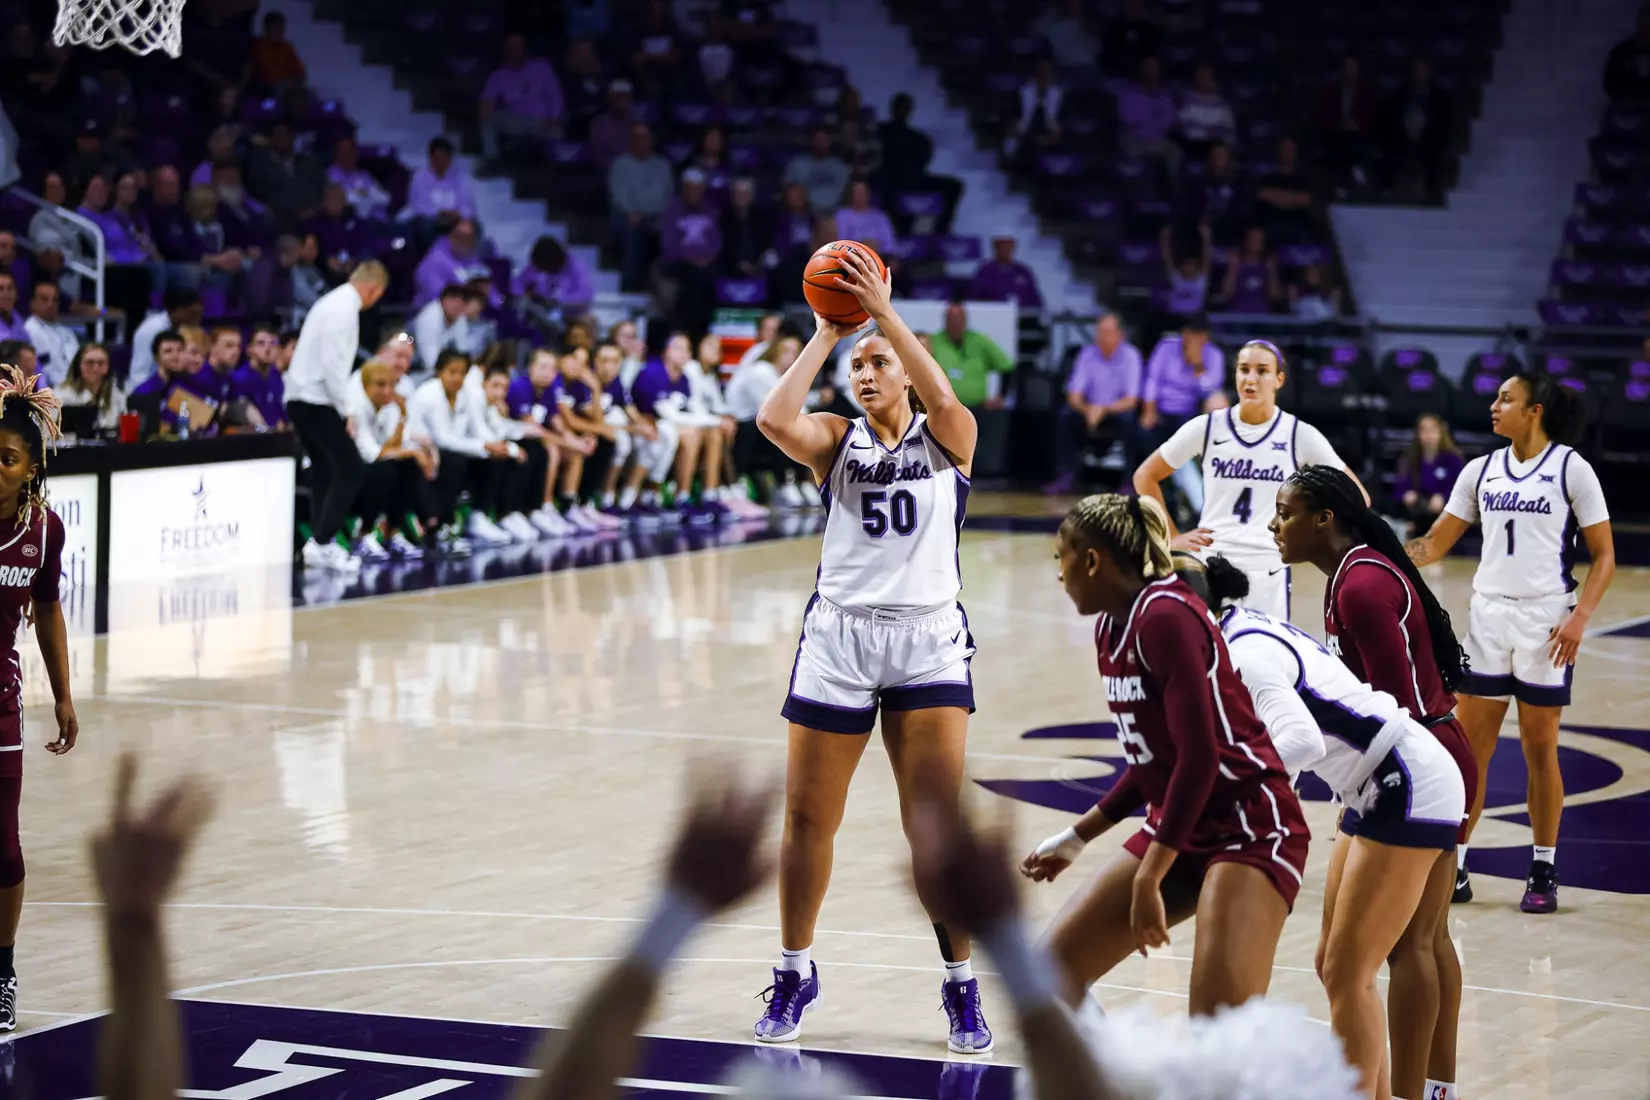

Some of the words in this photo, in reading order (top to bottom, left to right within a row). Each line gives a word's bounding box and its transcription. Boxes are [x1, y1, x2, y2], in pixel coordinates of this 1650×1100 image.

[847, 460, 933, 485] Wildcats
[1211, 457, 1285, 482] Wildcats
[861, 489, 918, 538] 50
[1232, 487, 1253, 524] 4
[1483, 491, 1552, 514] Wildcats
[160, 522, 240, 552] FREEDOM
[1504, 519, 1515, 556] 1
[0, 565, 37, 588] ROCK
[1115, 675, 1147, 703] ROCK
